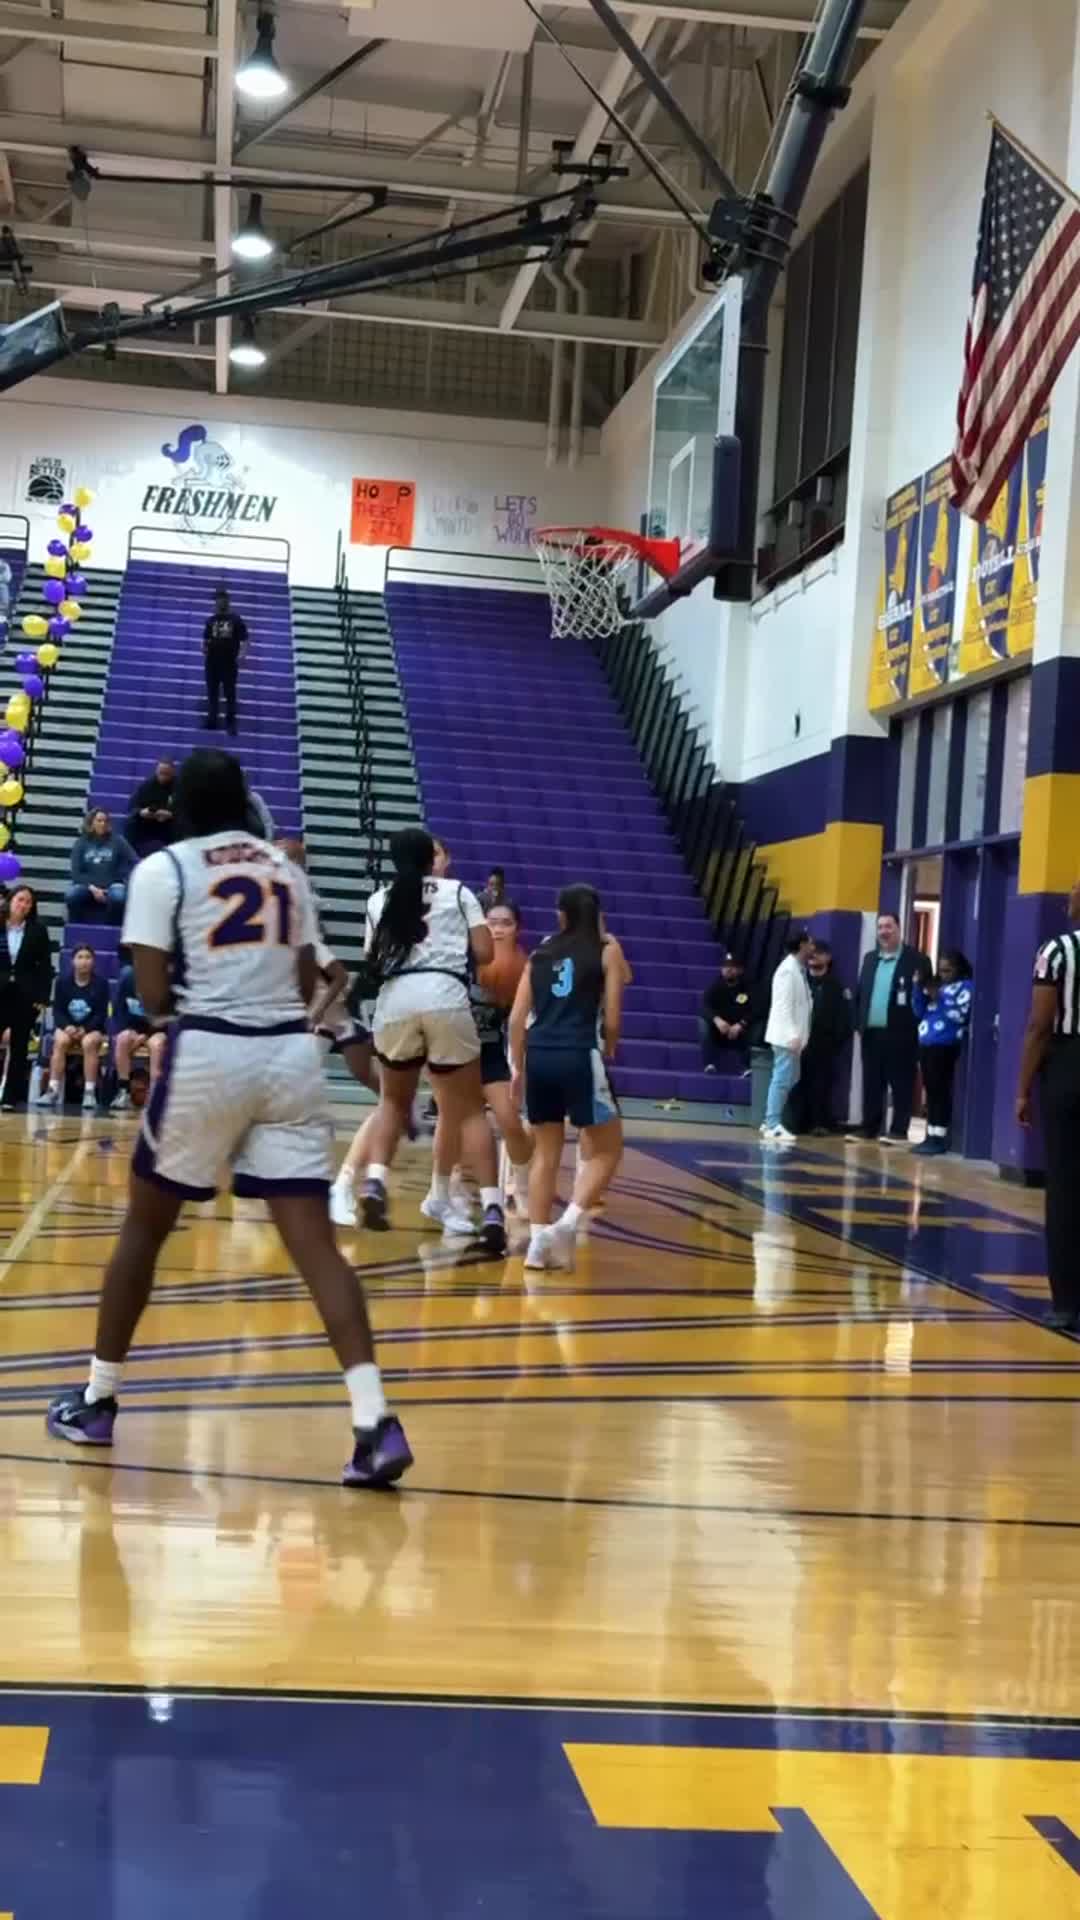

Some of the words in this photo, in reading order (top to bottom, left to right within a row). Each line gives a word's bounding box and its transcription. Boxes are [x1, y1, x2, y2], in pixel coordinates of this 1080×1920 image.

[141, 484, 278, 522] FRESHMEN
[493, 495, 537, 515] LETS
[208, 875, 297, 949] 21
[551, 957, 575, 998] 3
